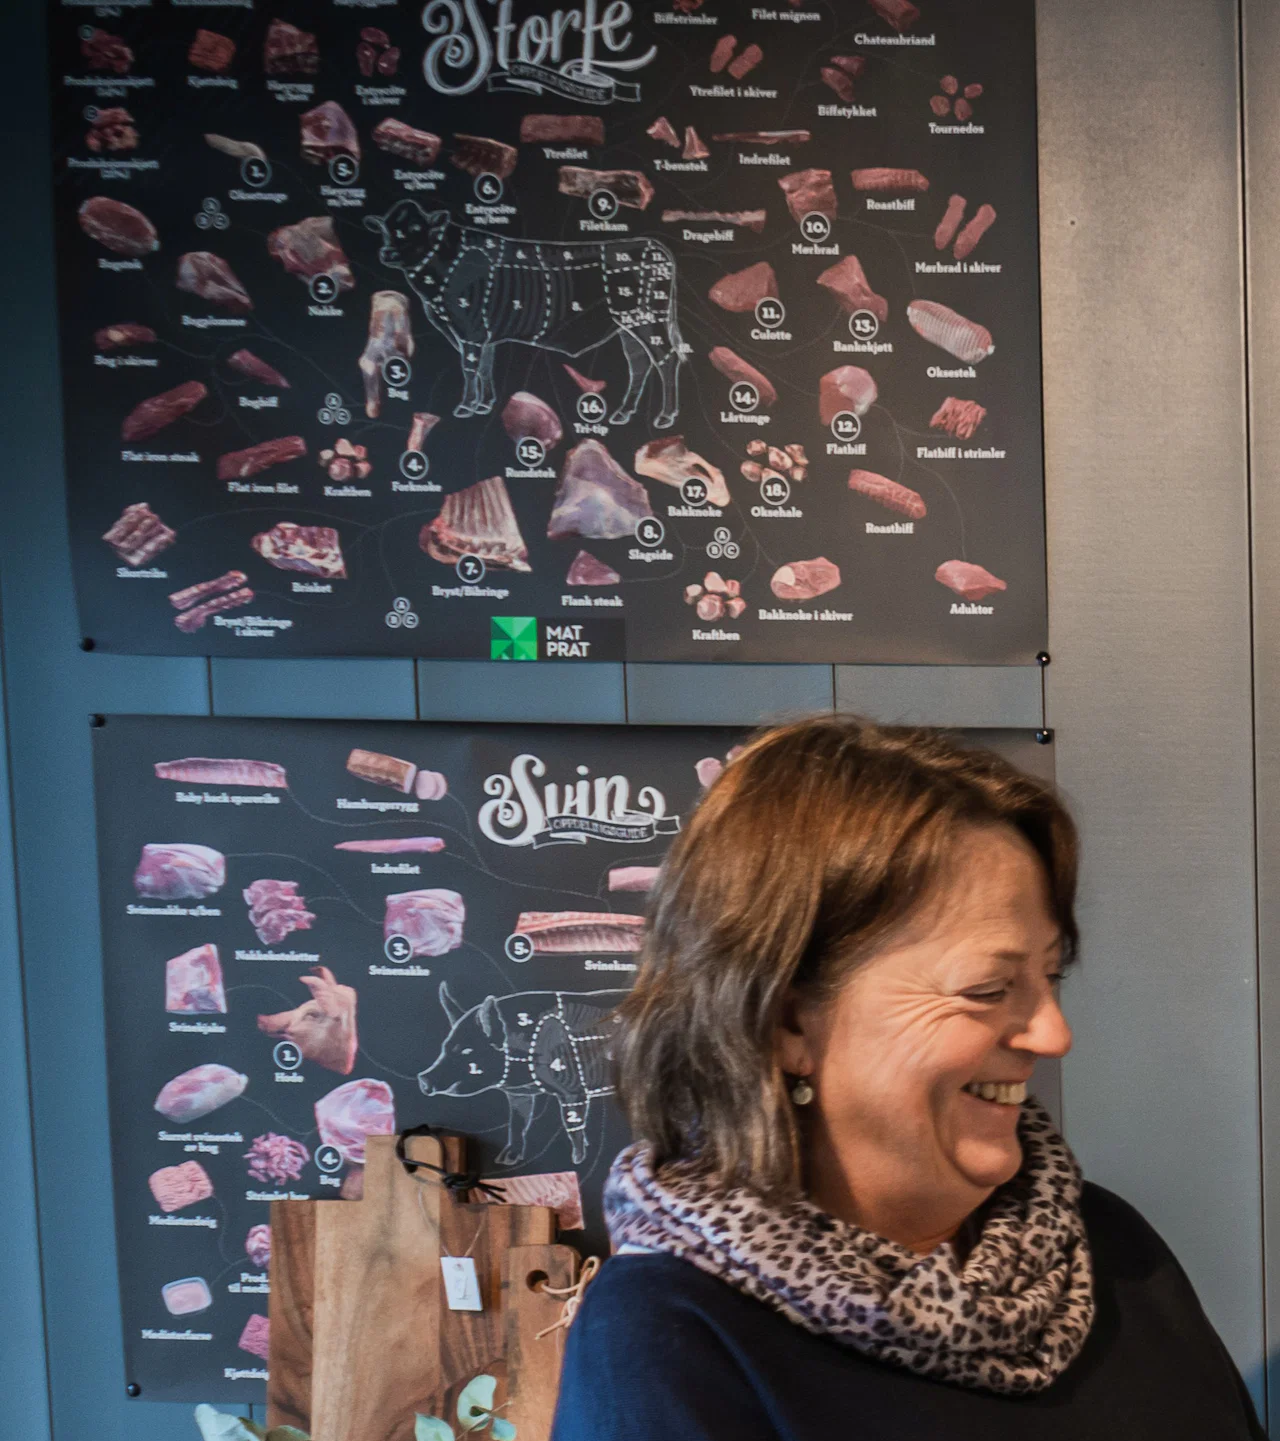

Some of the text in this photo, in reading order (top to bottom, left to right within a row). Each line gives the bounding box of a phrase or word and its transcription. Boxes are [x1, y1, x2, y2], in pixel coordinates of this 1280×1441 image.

[654, 13, 717, 26] Biffstrimler
[752, 9, 820, 23] Filet mignon
[854, 34, 935, 47] Chateaubriand
[422, 0, 647, 96] Storfe
[689, 86, 735, 98] Ytrefilet
[745, 87, 777, 98] skiver
[818, 105, 877, 118] Biffstykket
[929, 122, 984, 135] Tournedos
[739, 153, 791, 166] Indrefilet
[866, 198, 916, 211] Roastbiff
[579, 219, 629, 232] Filetkam
[805, 220, 828, 234] 10.
[683, 230, 734, 243] Dragebiff
[791, 243, 840, 256] Mørbrad
[915, 262, 961, 274] Mørbrad
[969, 262, 1001, 274] skiver
[761, 307, 781, 319] 11.
[854, 319, 875, 332] 13.
[750, 328, 792, 341] Culotte
[833, 341, 893, 355] Bankekjøtt
[926, 366, 976, 378] Oksestek
[734, 390, 756, 403] 14.
[581, 400, 603, 415] 16.
[836, 420, 858, 432] 12.
[520, 444, 542, 459] 15.
[826, 443, 867, 454] Flatbiff
[917, 447, 957, 459] Flatbiff
[964, 448, 1006, 459] strimler
[685, 484, 705, 497] 17.
[766, 484, 786, 497] 18.
[668, 506, 723, 517] Bakknoke
[751, 506, 803, 518] Oksehale
[865, 522, 914, 535] Roastbiff
[758, 609, 812, 621] Bakknoke
[820, 610, 853, 622] skiver
[949, 603, 994, 616] Aduktor
[546, 625, 583, 641] MAT
[692, 629, 741, 642] Kraftben
[546, 641, 591, 657] PRAT
[478, 754, 666, 847] Svin
